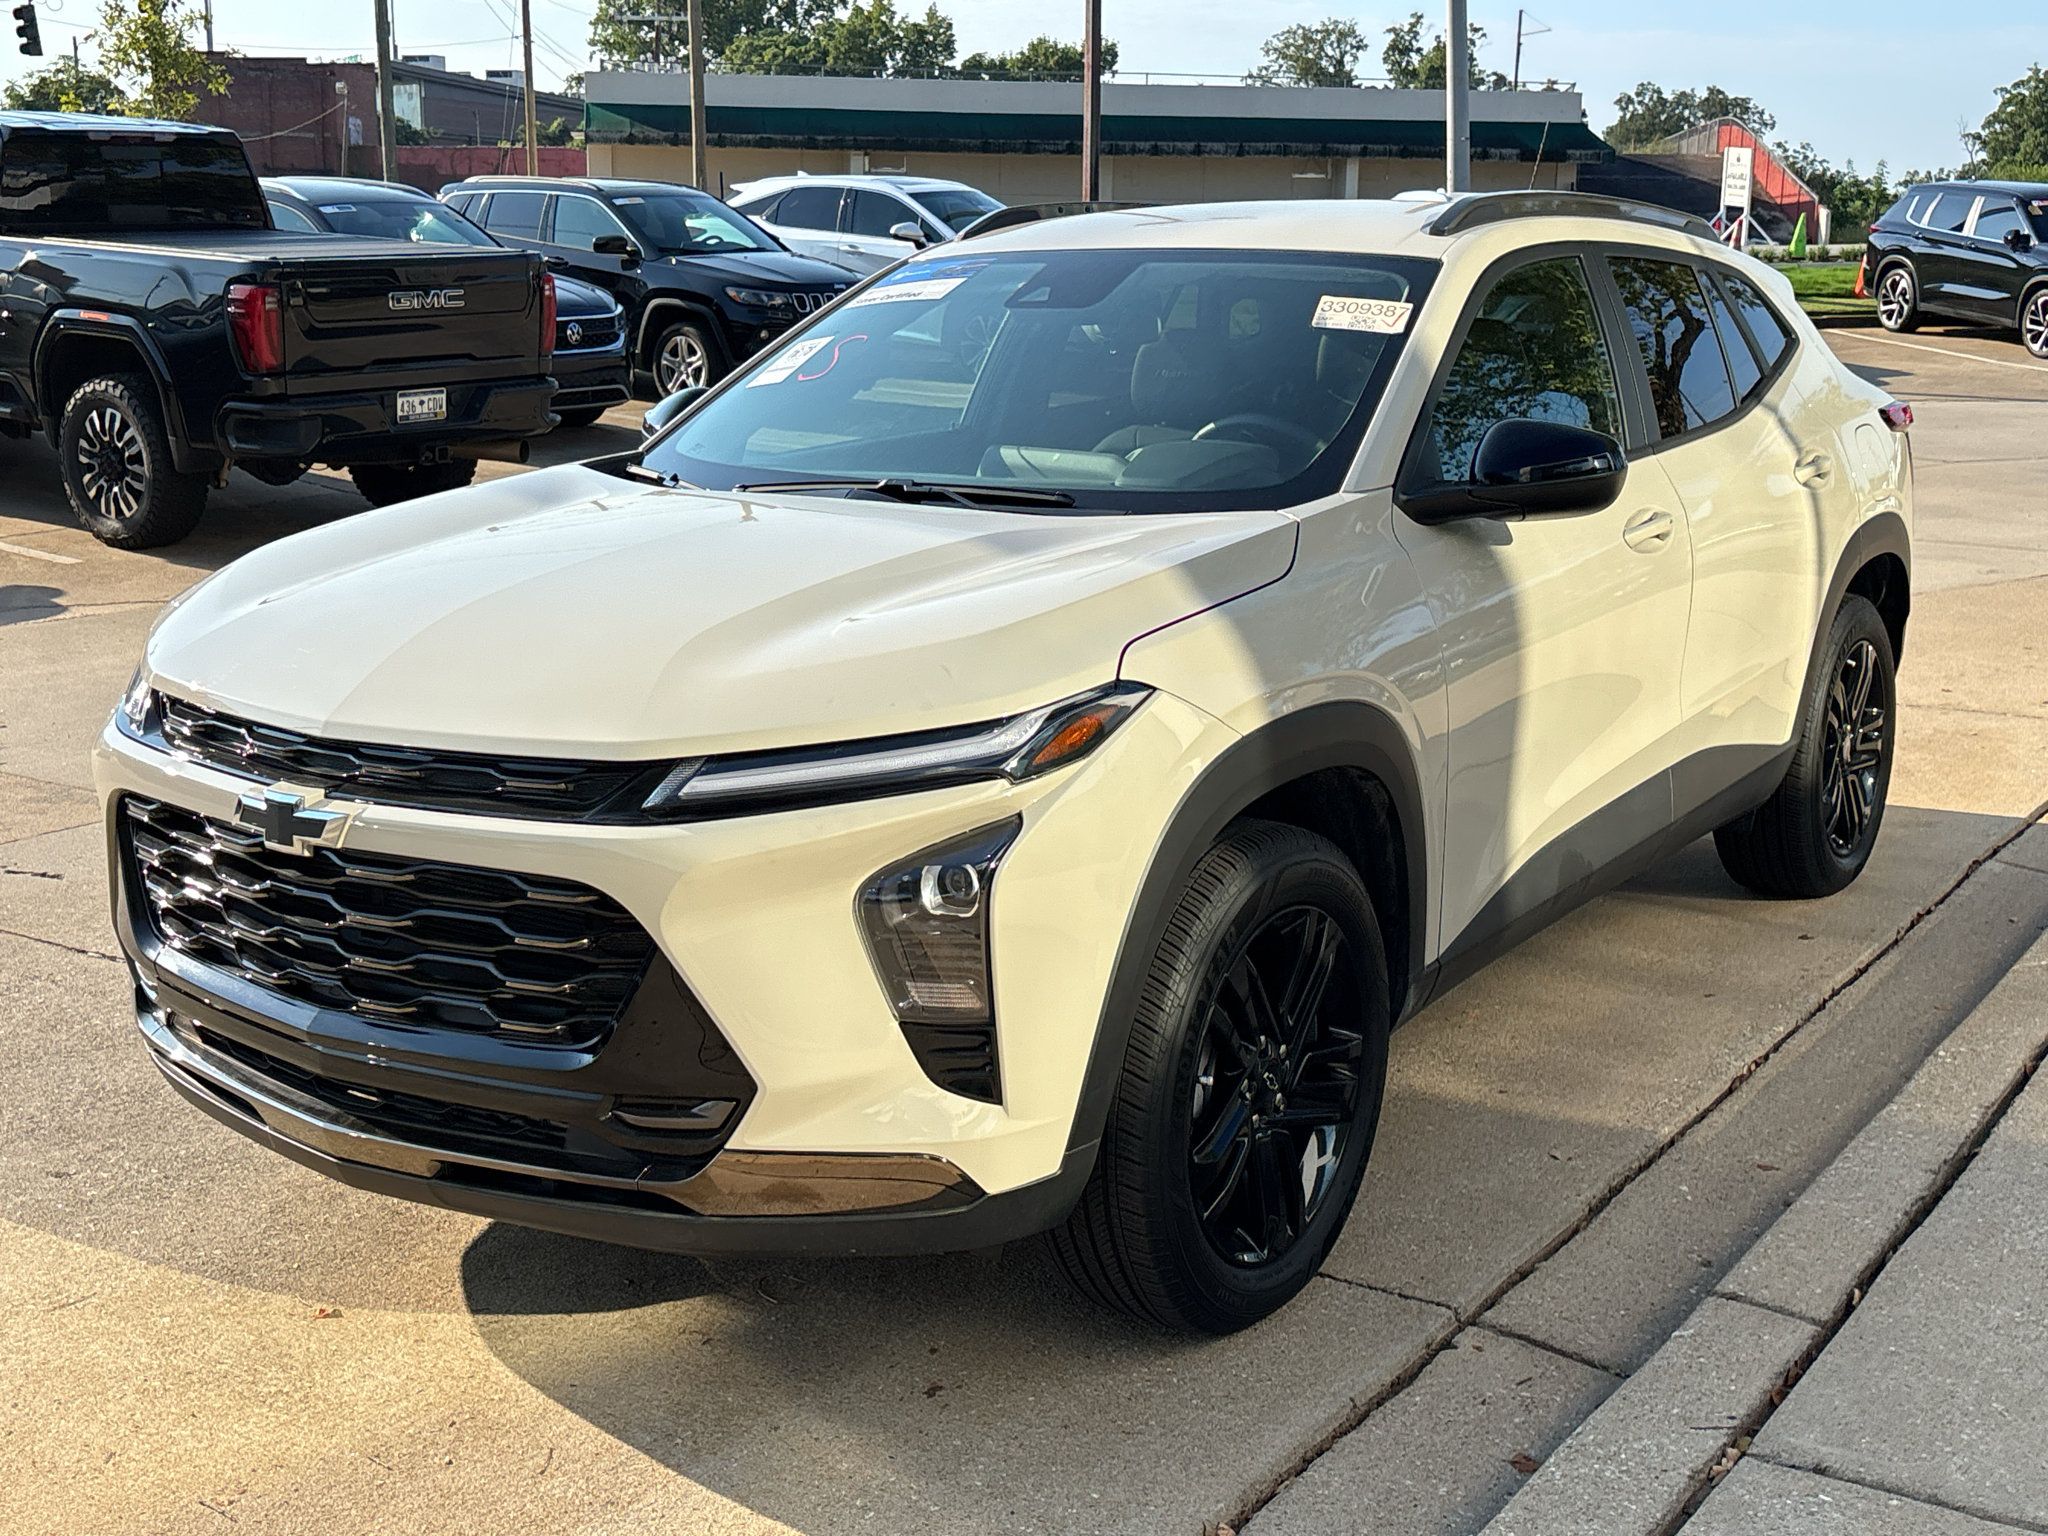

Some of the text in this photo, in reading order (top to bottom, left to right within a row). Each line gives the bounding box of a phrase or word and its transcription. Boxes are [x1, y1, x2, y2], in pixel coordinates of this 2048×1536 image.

[388, 289, 465, 310] GMC
[1320, 300, 1411, 320] 3309387
[400, 400, 417, 415] 436
